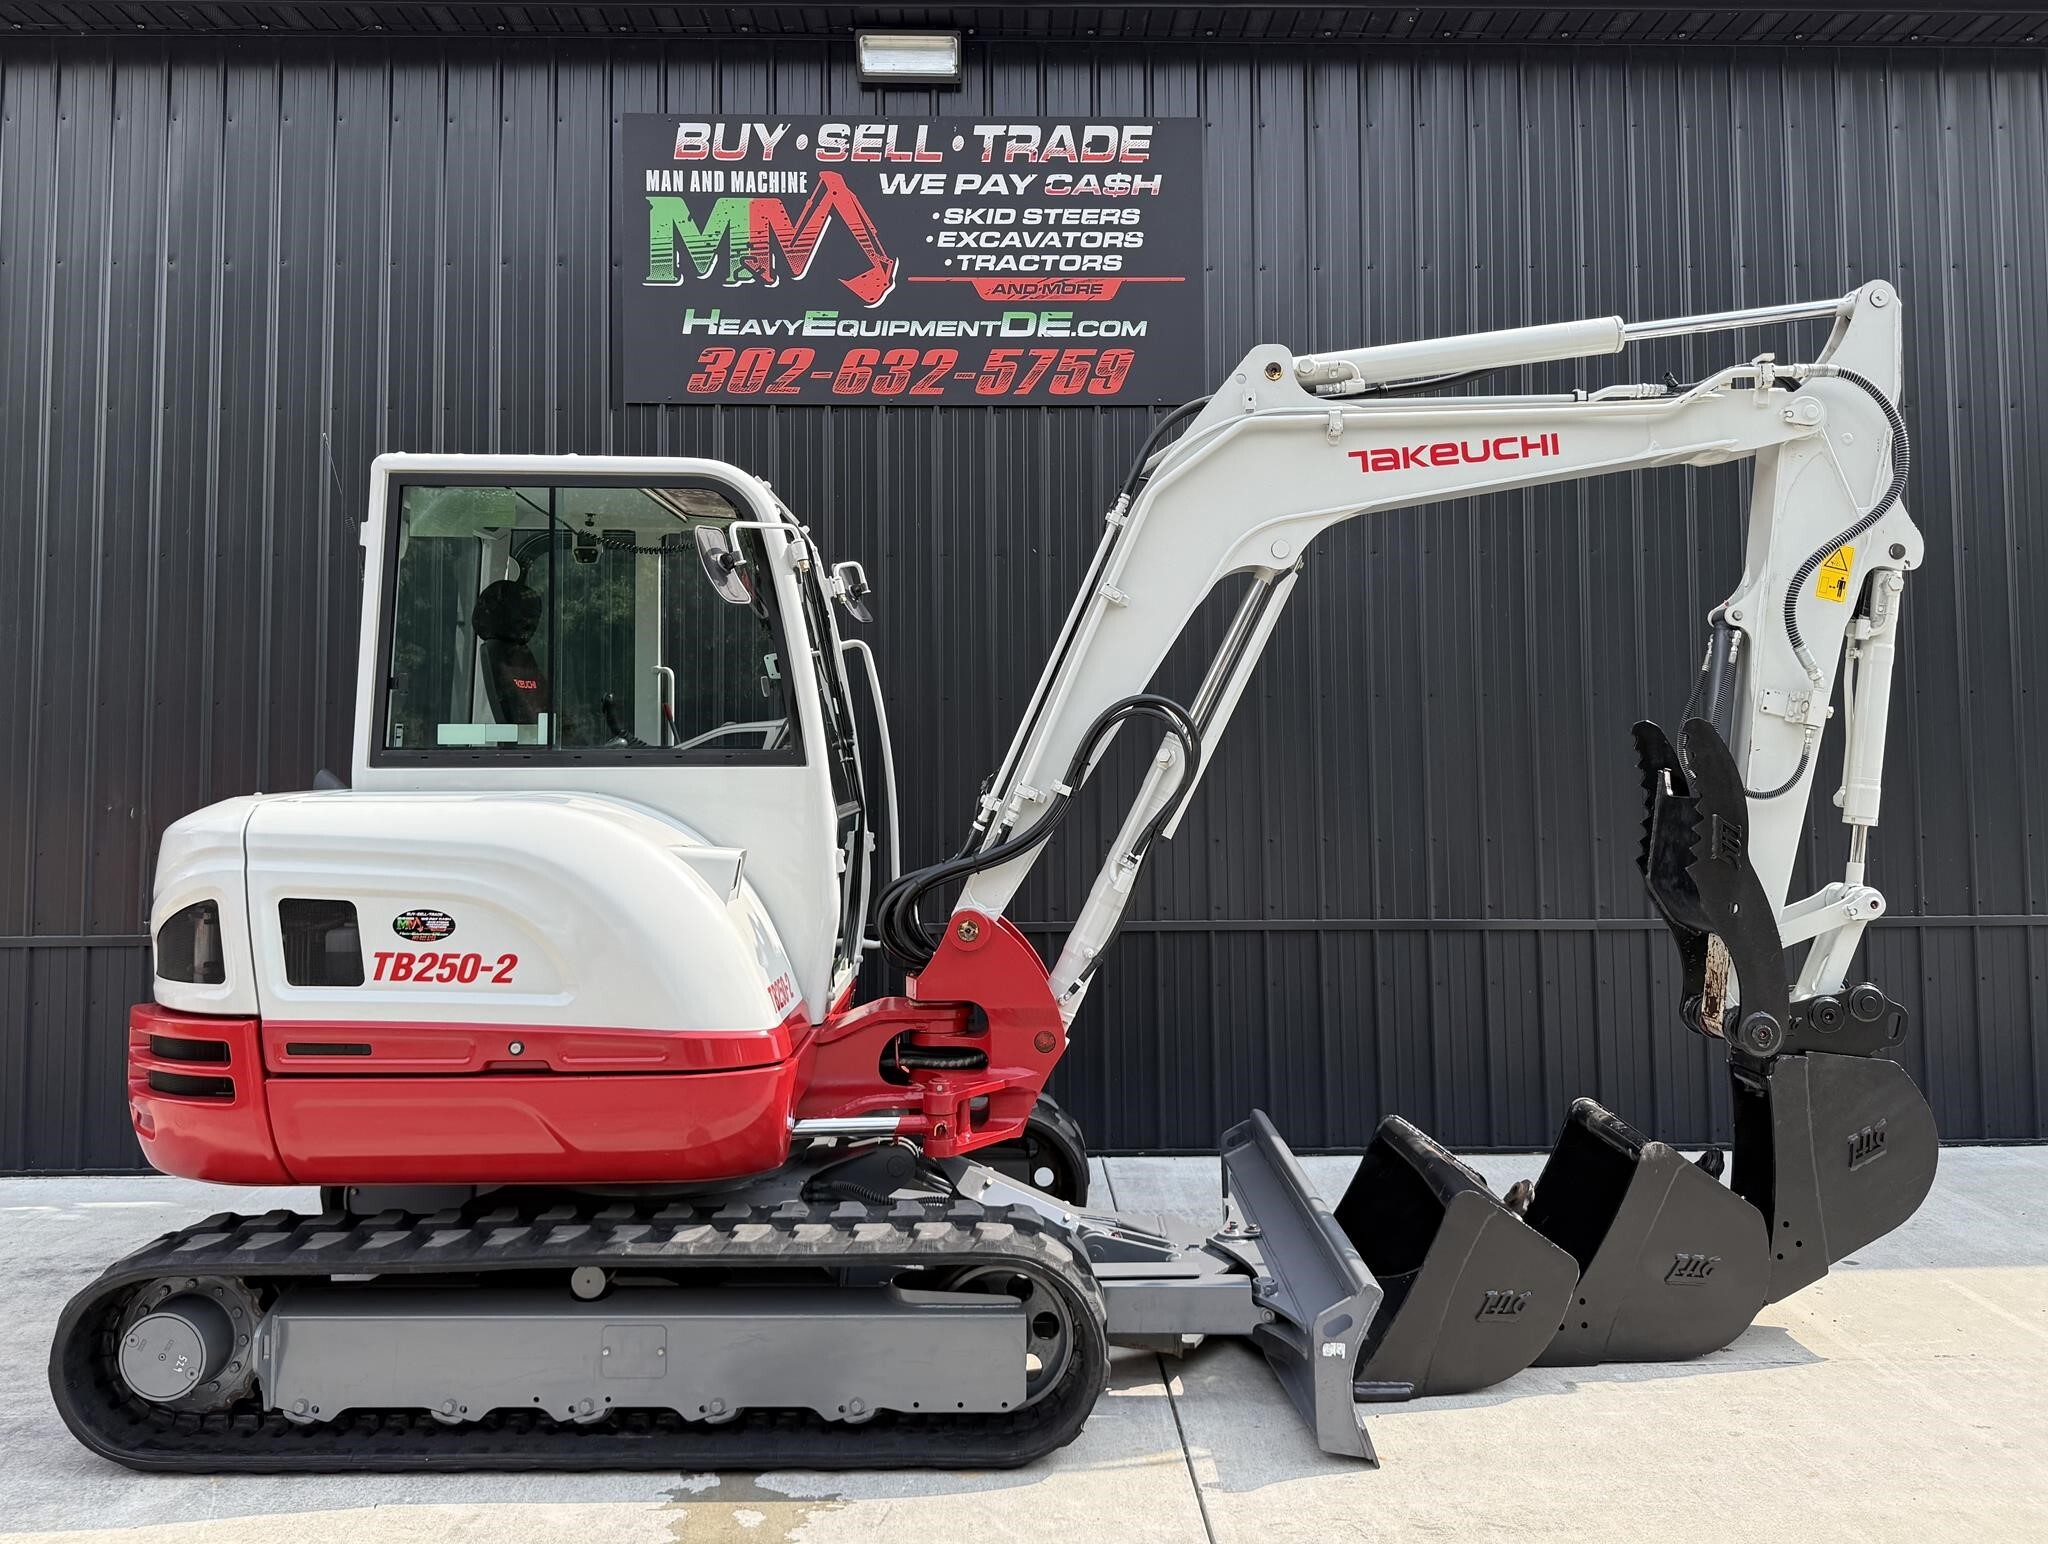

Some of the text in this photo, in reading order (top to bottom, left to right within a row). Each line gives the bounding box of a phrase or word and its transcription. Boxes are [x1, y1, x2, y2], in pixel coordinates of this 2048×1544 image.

[673, 122, 1154, 163] BUY SELL TRADE
[645, 169, 808, 194] MAN AND MACHINE
[879, 172, 1162, 198] WE PAY CA$H
[943, 208, 1141, 225] SKID STEERS
[937, 231, 1144, 248] EXCAVATORS
[956, 254, 1123, 271] TRACTORS
[991, 283, 1103, 295] AND MORE
[687, 347, 1136, 395] 302-632-5759
[373, 951, 518, 984] TB250-2
